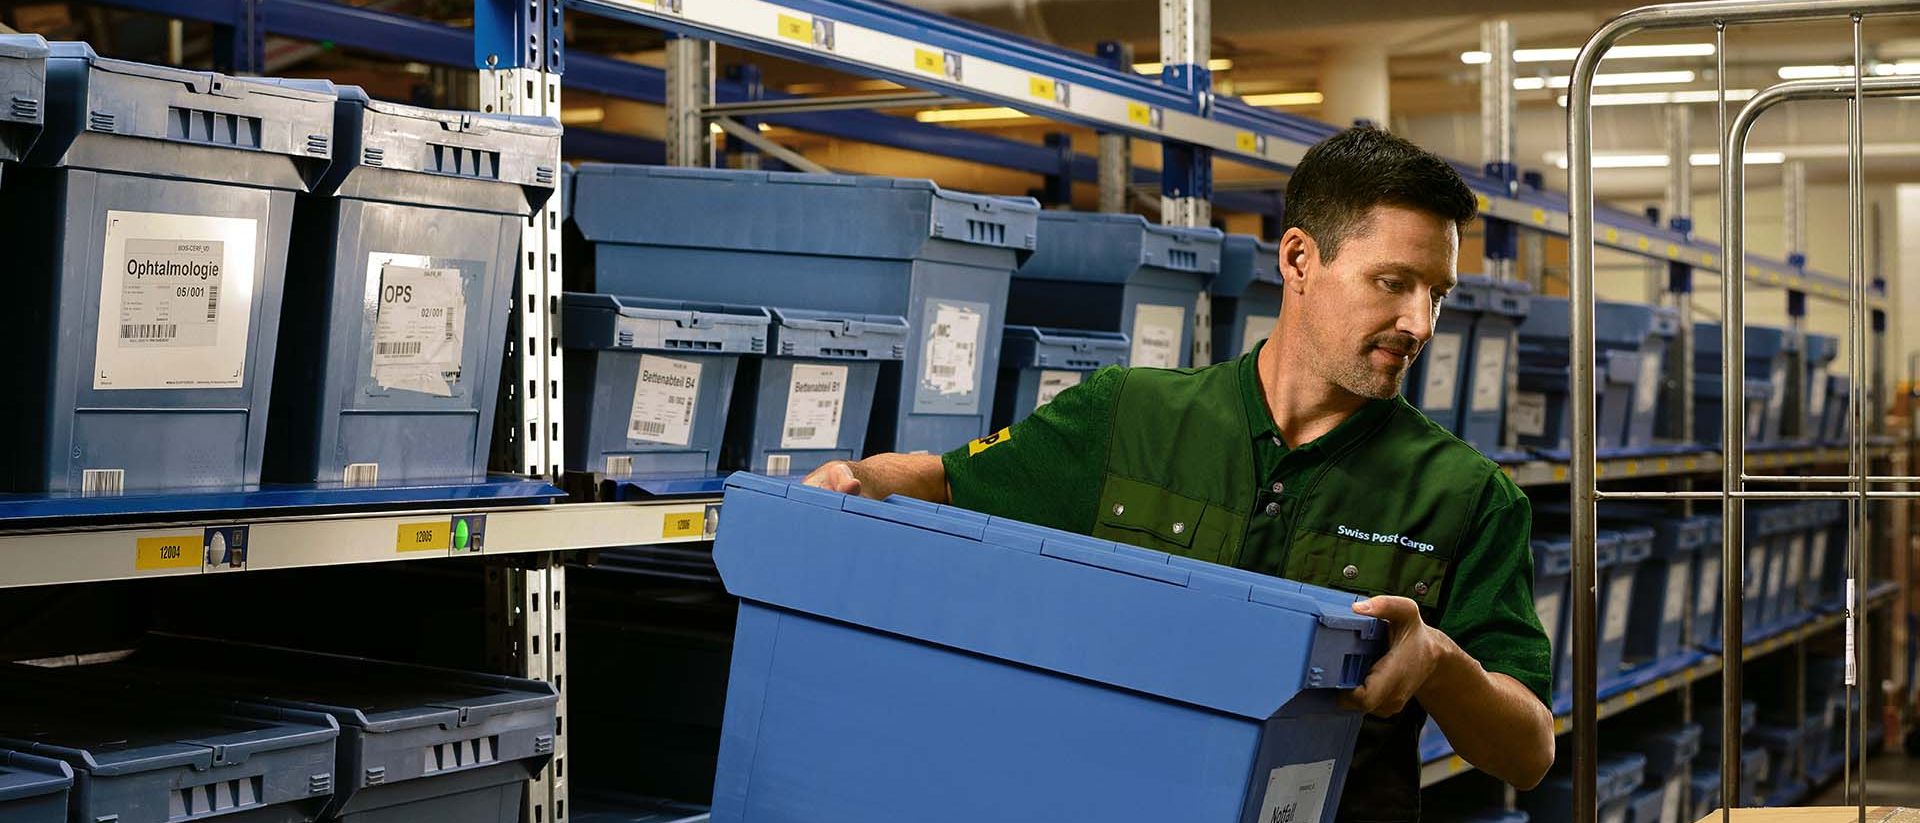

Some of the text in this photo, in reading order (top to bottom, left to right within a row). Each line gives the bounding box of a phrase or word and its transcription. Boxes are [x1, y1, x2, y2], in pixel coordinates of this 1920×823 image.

[127, 259, 219, 280] Ophtalmologie
[176, 286, 204, 297] 05/001
[384, 285, 412, 303] OPS
[643, 370, 696, 388] Bettenabteil B4
[795, 382, 831, 393] Bettenabteil
[416, 530, 432, 543] 12005
[1337, 525, 1435, 553] Swiss Post Cargo
[160, 545, 181, 559] 12004
